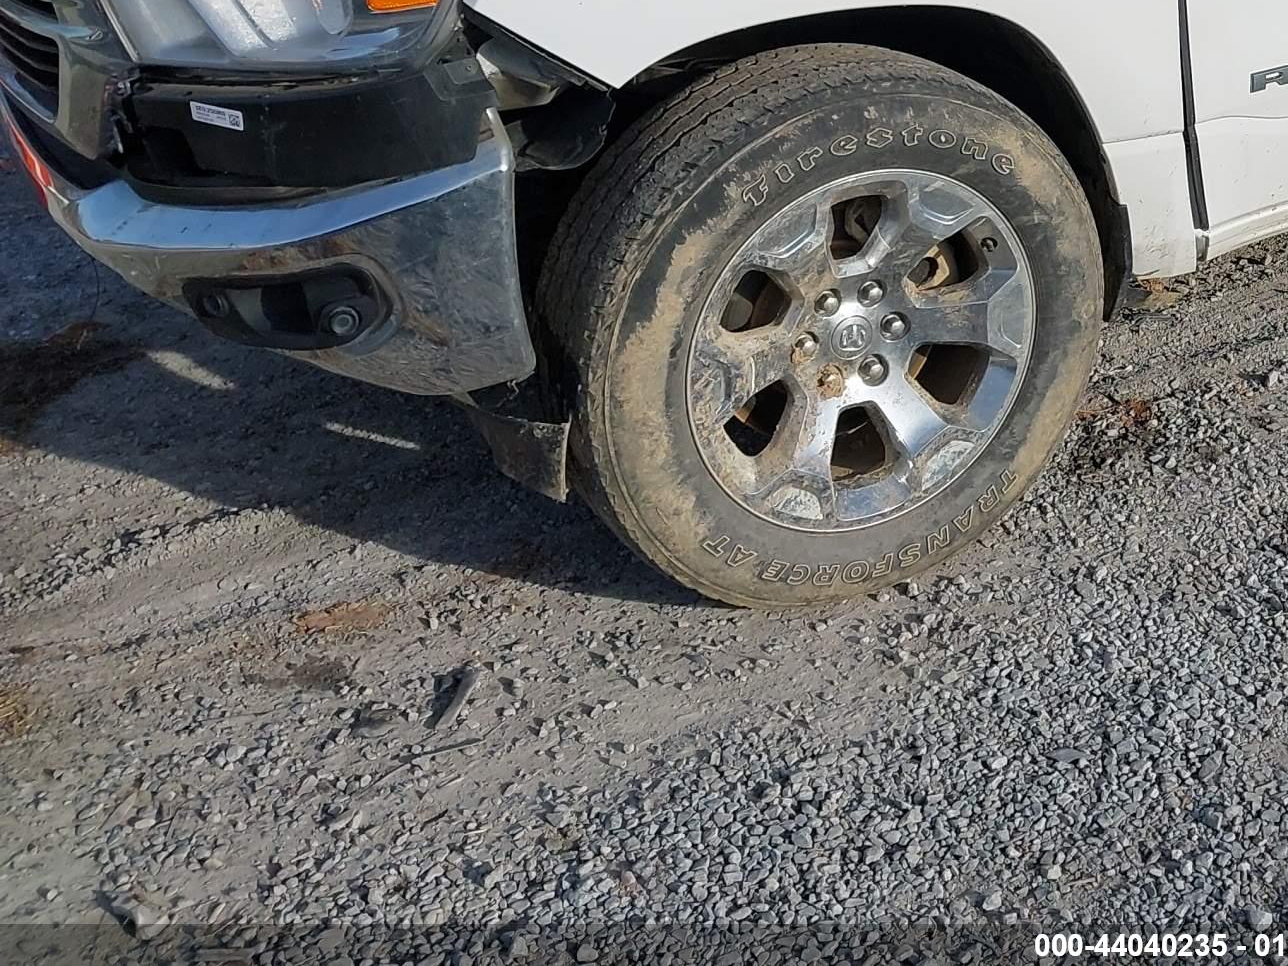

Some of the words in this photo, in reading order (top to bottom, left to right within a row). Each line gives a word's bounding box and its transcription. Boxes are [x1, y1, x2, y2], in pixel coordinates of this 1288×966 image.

[742, 123, 1016, 207] Firestone
[702, 533, 759, 568] AT
[760, 467, 1019, 586] TRANSFORCE
